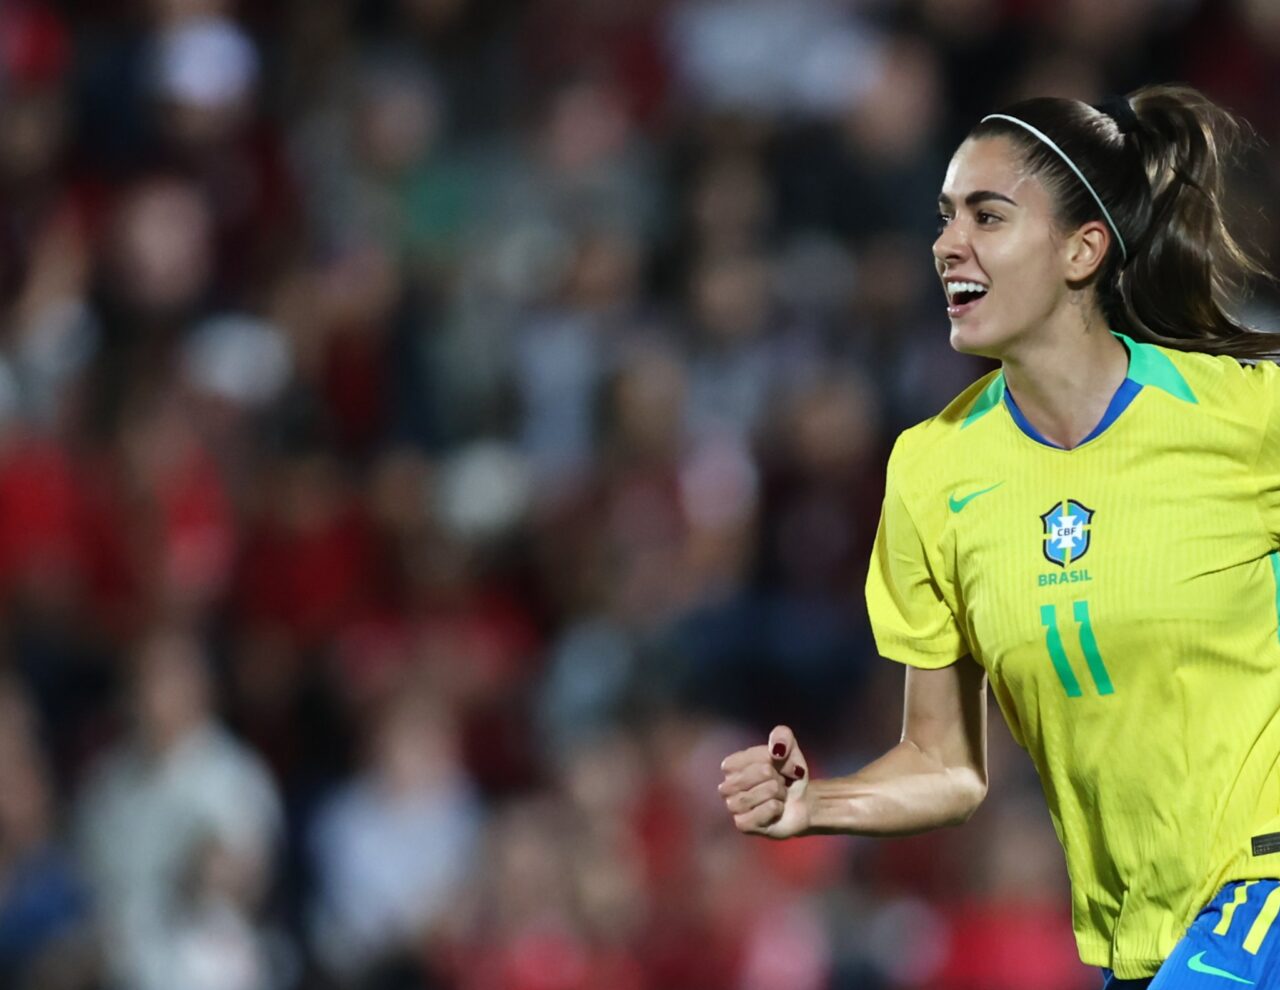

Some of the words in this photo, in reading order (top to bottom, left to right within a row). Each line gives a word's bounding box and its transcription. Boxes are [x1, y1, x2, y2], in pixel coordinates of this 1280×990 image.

[1057, 527, 1077, 537] CBF
[1038, 569, 1092, 587] BRASIL
[1040, 600, 1115, 698] 11
